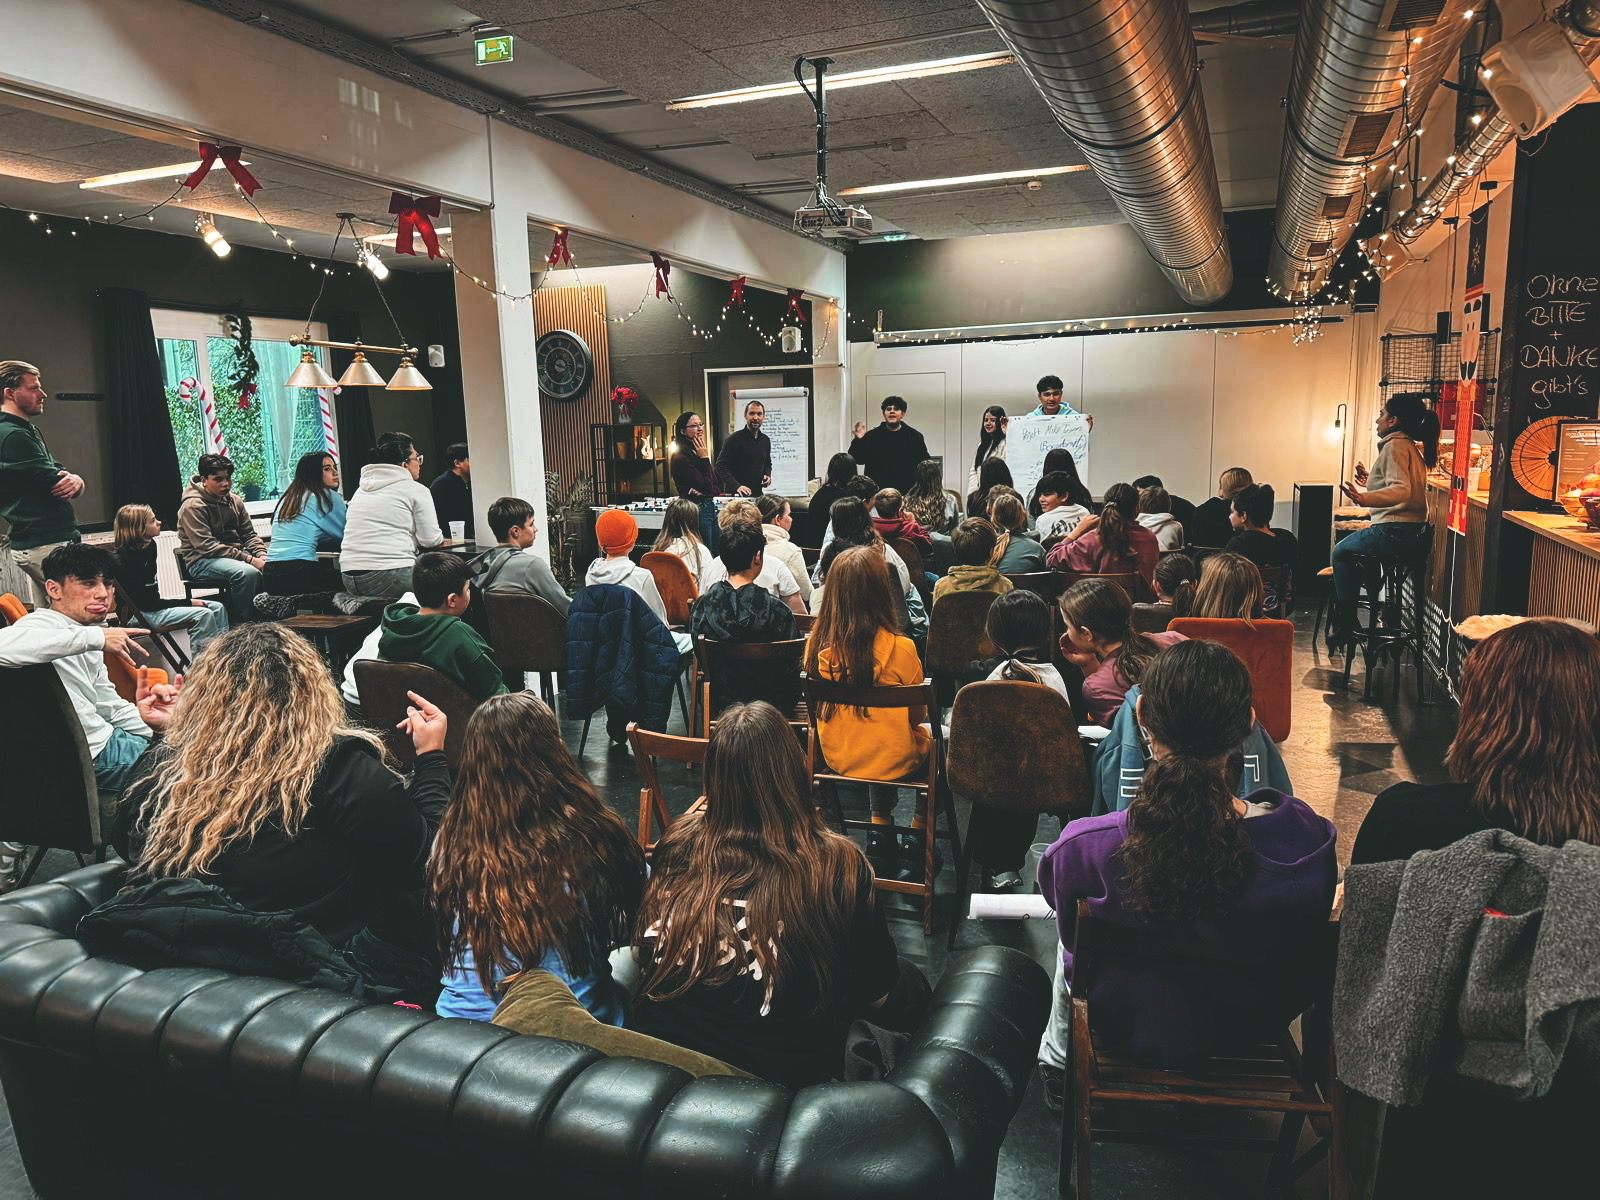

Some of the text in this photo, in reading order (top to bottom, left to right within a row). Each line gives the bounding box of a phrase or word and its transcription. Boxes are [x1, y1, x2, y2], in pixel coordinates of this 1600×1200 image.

[1525, 300, 1591, 326] BITTE
[1549, 330, 1563, 340] +
[1520, 344, 1600, 368] DANKE
[1531, 374, 1589, 410] gibt's
